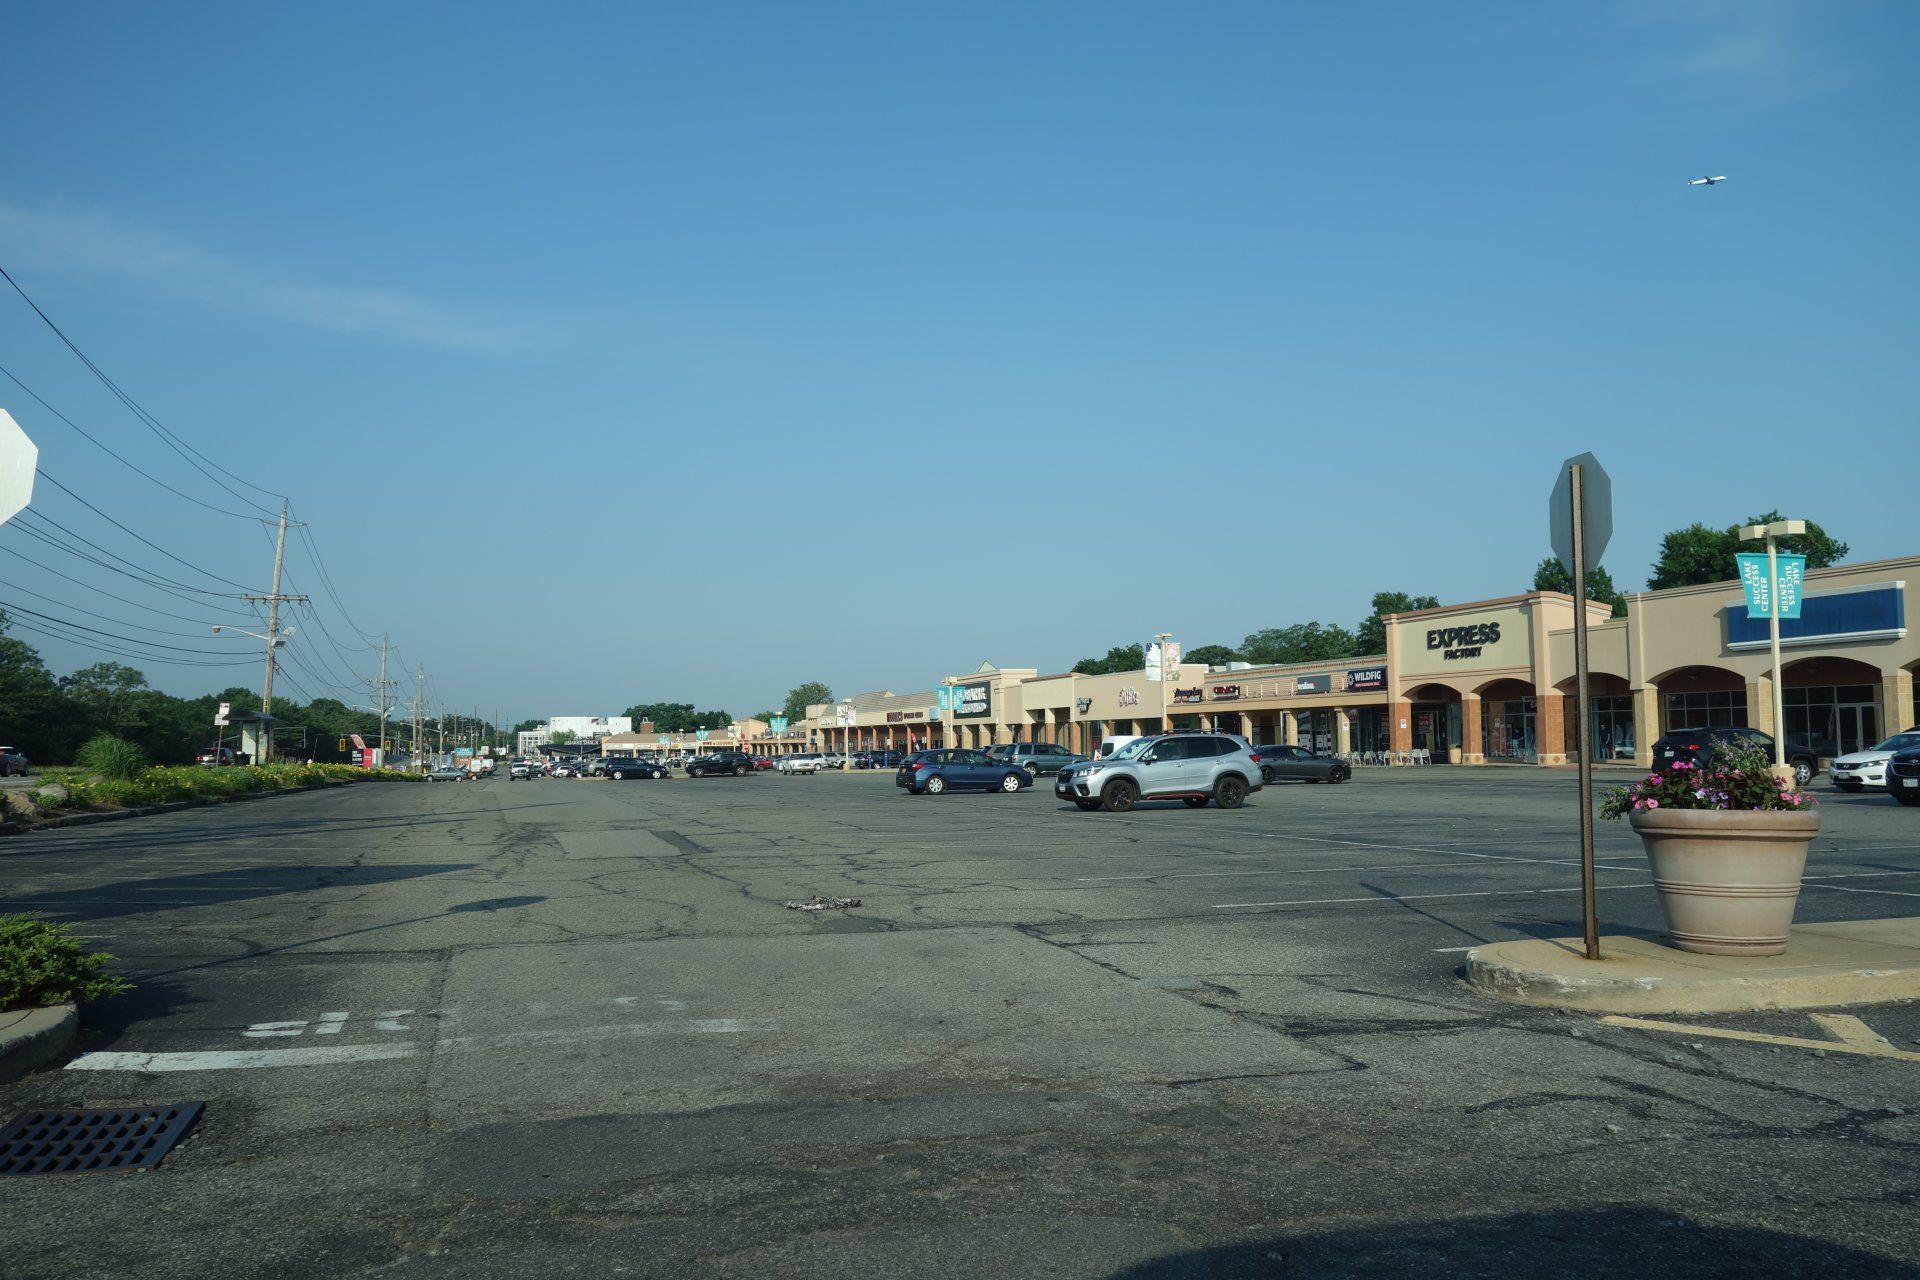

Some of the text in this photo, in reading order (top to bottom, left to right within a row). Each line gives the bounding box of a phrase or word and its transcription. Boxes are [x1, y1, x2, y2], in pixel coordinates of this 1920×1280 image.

[1744, 561, 1752, 585] LAKE
[1752, 564, 1761, 605] SUCCESS
[1785, 565, 1796, 605] SUCCESS
[1792, 562, 1800, 585] LAKE
[1779, 577, 1789, 612] CENTER
[1427, 622, 1501, 651] EXPRESS
[1444, 647, 1482, 660] FACTORY
[1354, 671, 1381, 682] WILDFIG
